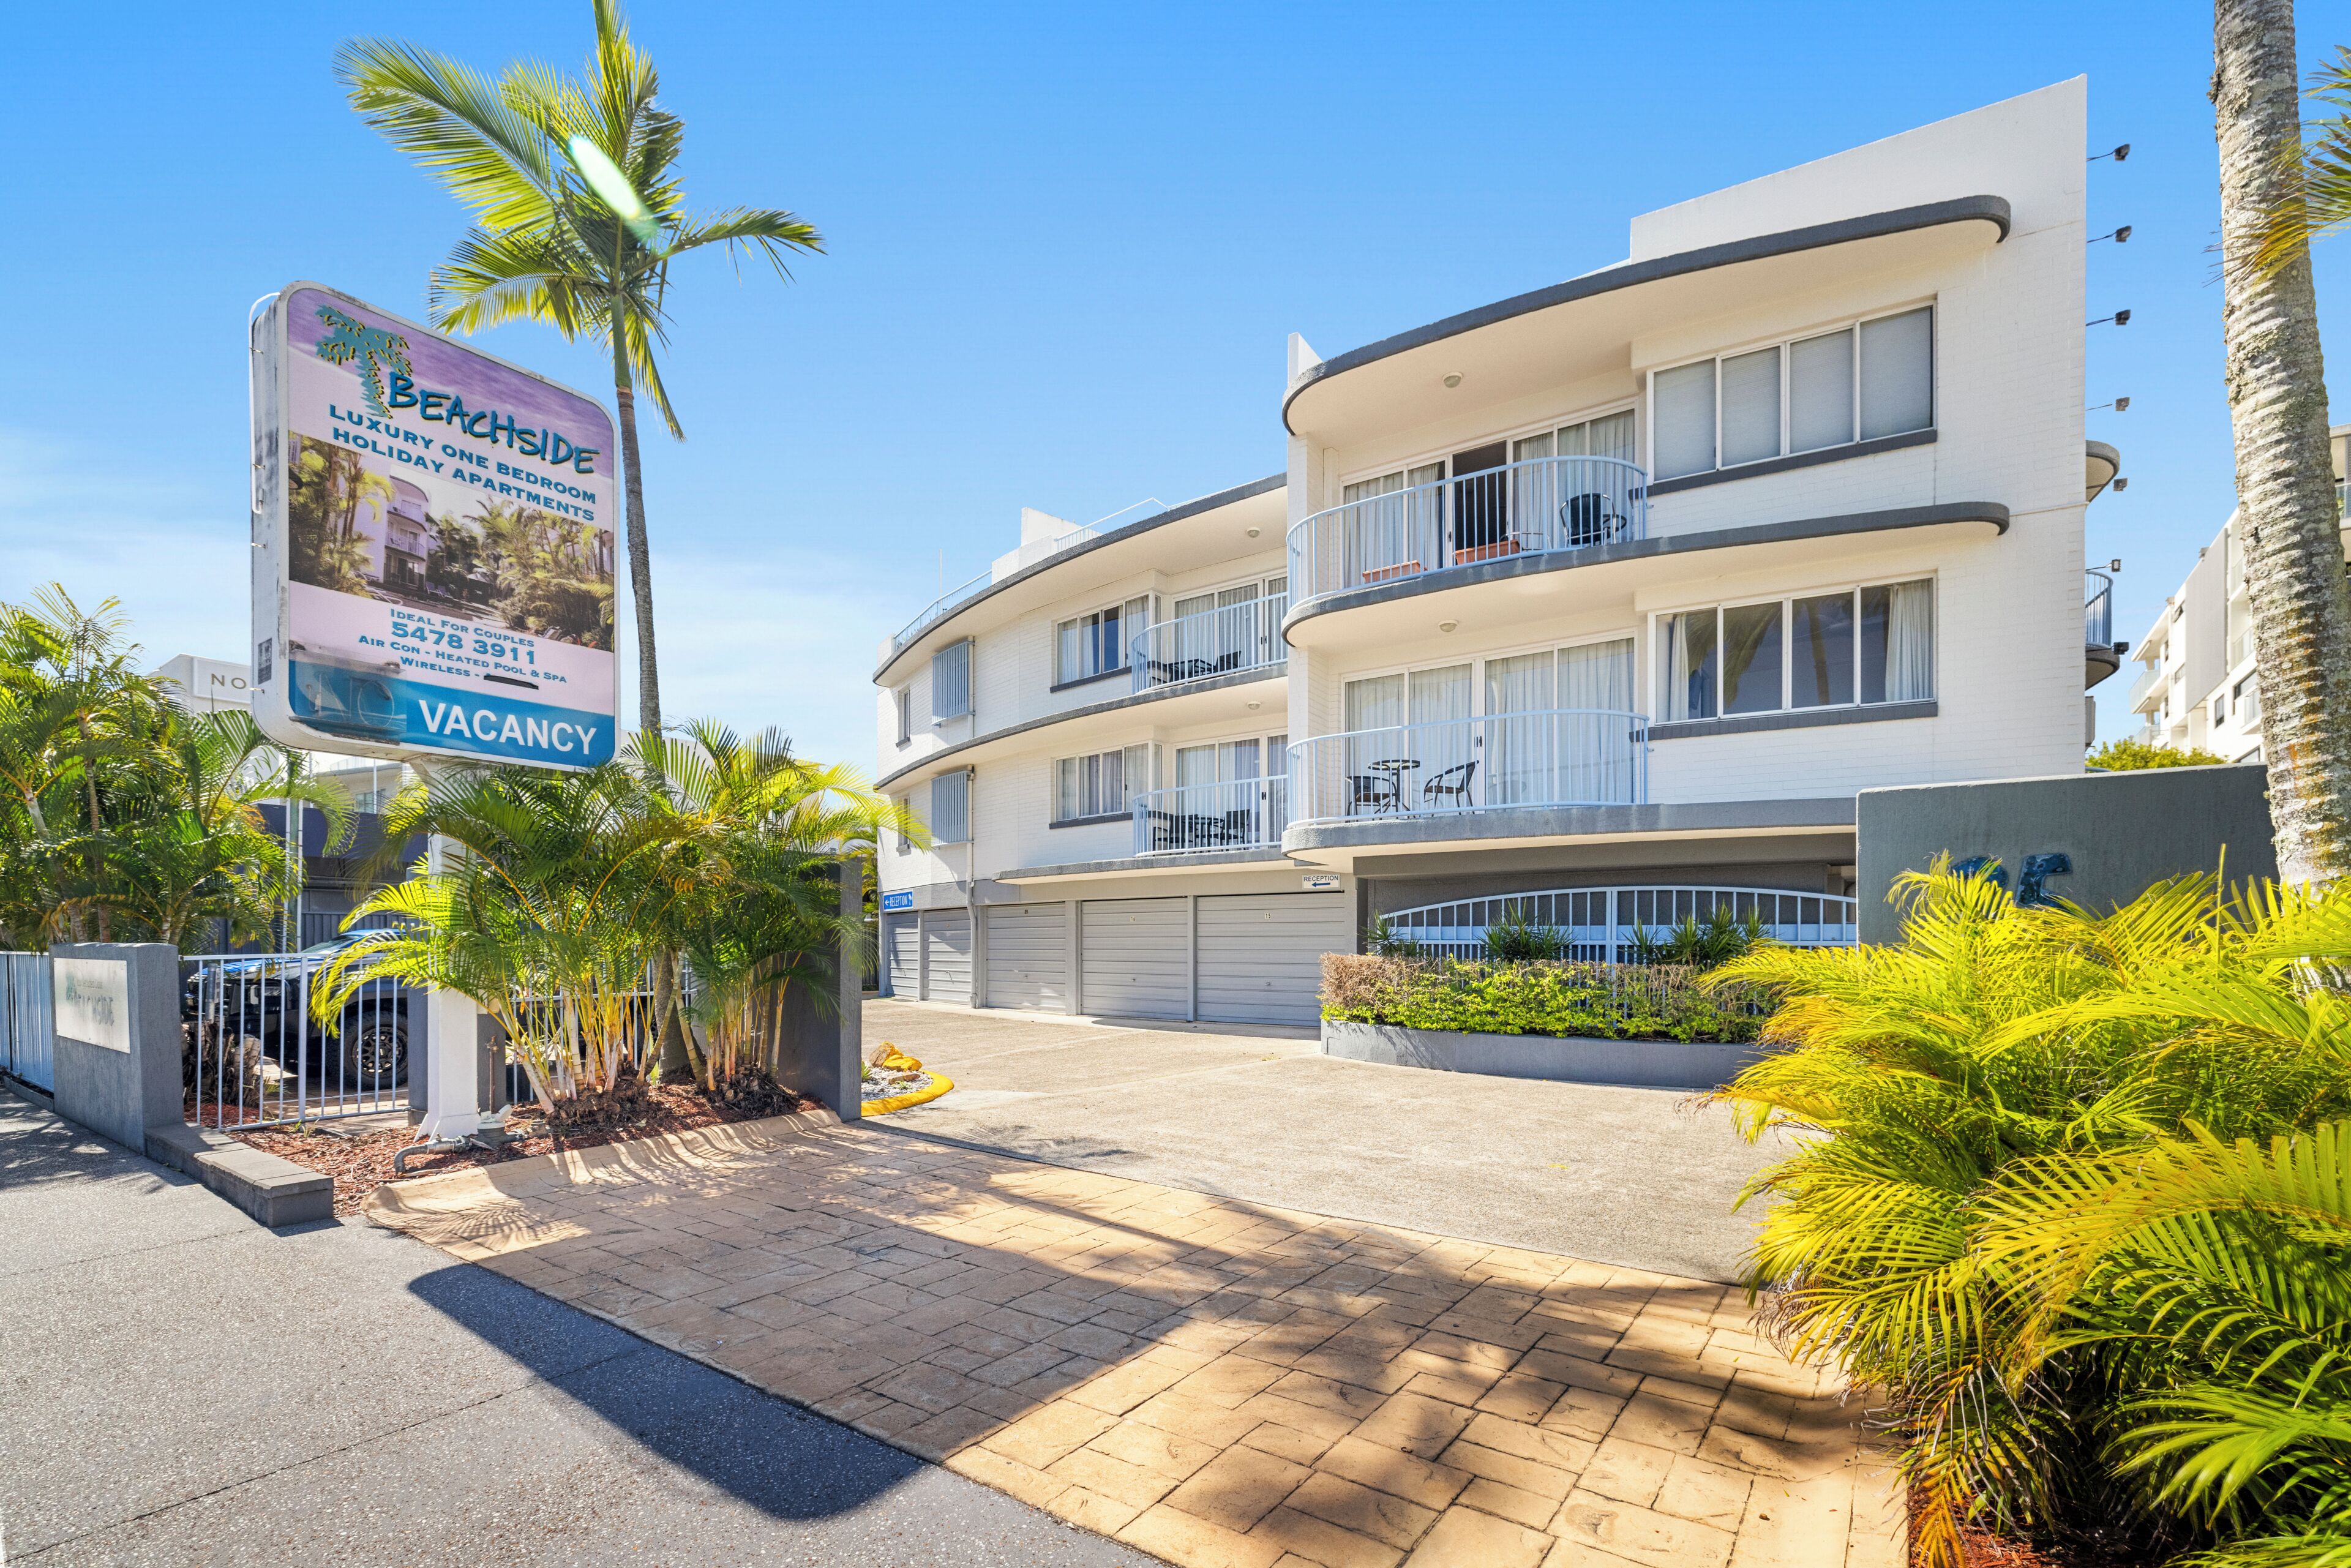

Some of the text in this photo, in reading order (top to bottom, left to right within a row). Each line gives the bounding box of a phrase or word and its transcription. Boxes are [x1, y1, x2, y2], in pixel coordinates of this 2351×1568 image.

[389, 372, 600, 475] BEACHSIDE
[329, 404, 596, 504] LUXURY ONE BEDROOM
[333, 427, 594, 522] HOLIDAY APARTMENTS
[391, 609, 534, 647] IDEAL FOR COUPLES
[391, 621, 534, 664] 5478 3911
[358, 636, 384, 647] AIR
[390, 642, 420, 655] CON
[435, 650, 489, 667] HEATED
[494, 662, 528, 675] POOL
[544, 671, 567, 683] SPA
[400, 656, 471, 677] WIRELESS
[418, 699, 597, 754] VACANCY
[890, 895, 908, 906] RECEPTION
